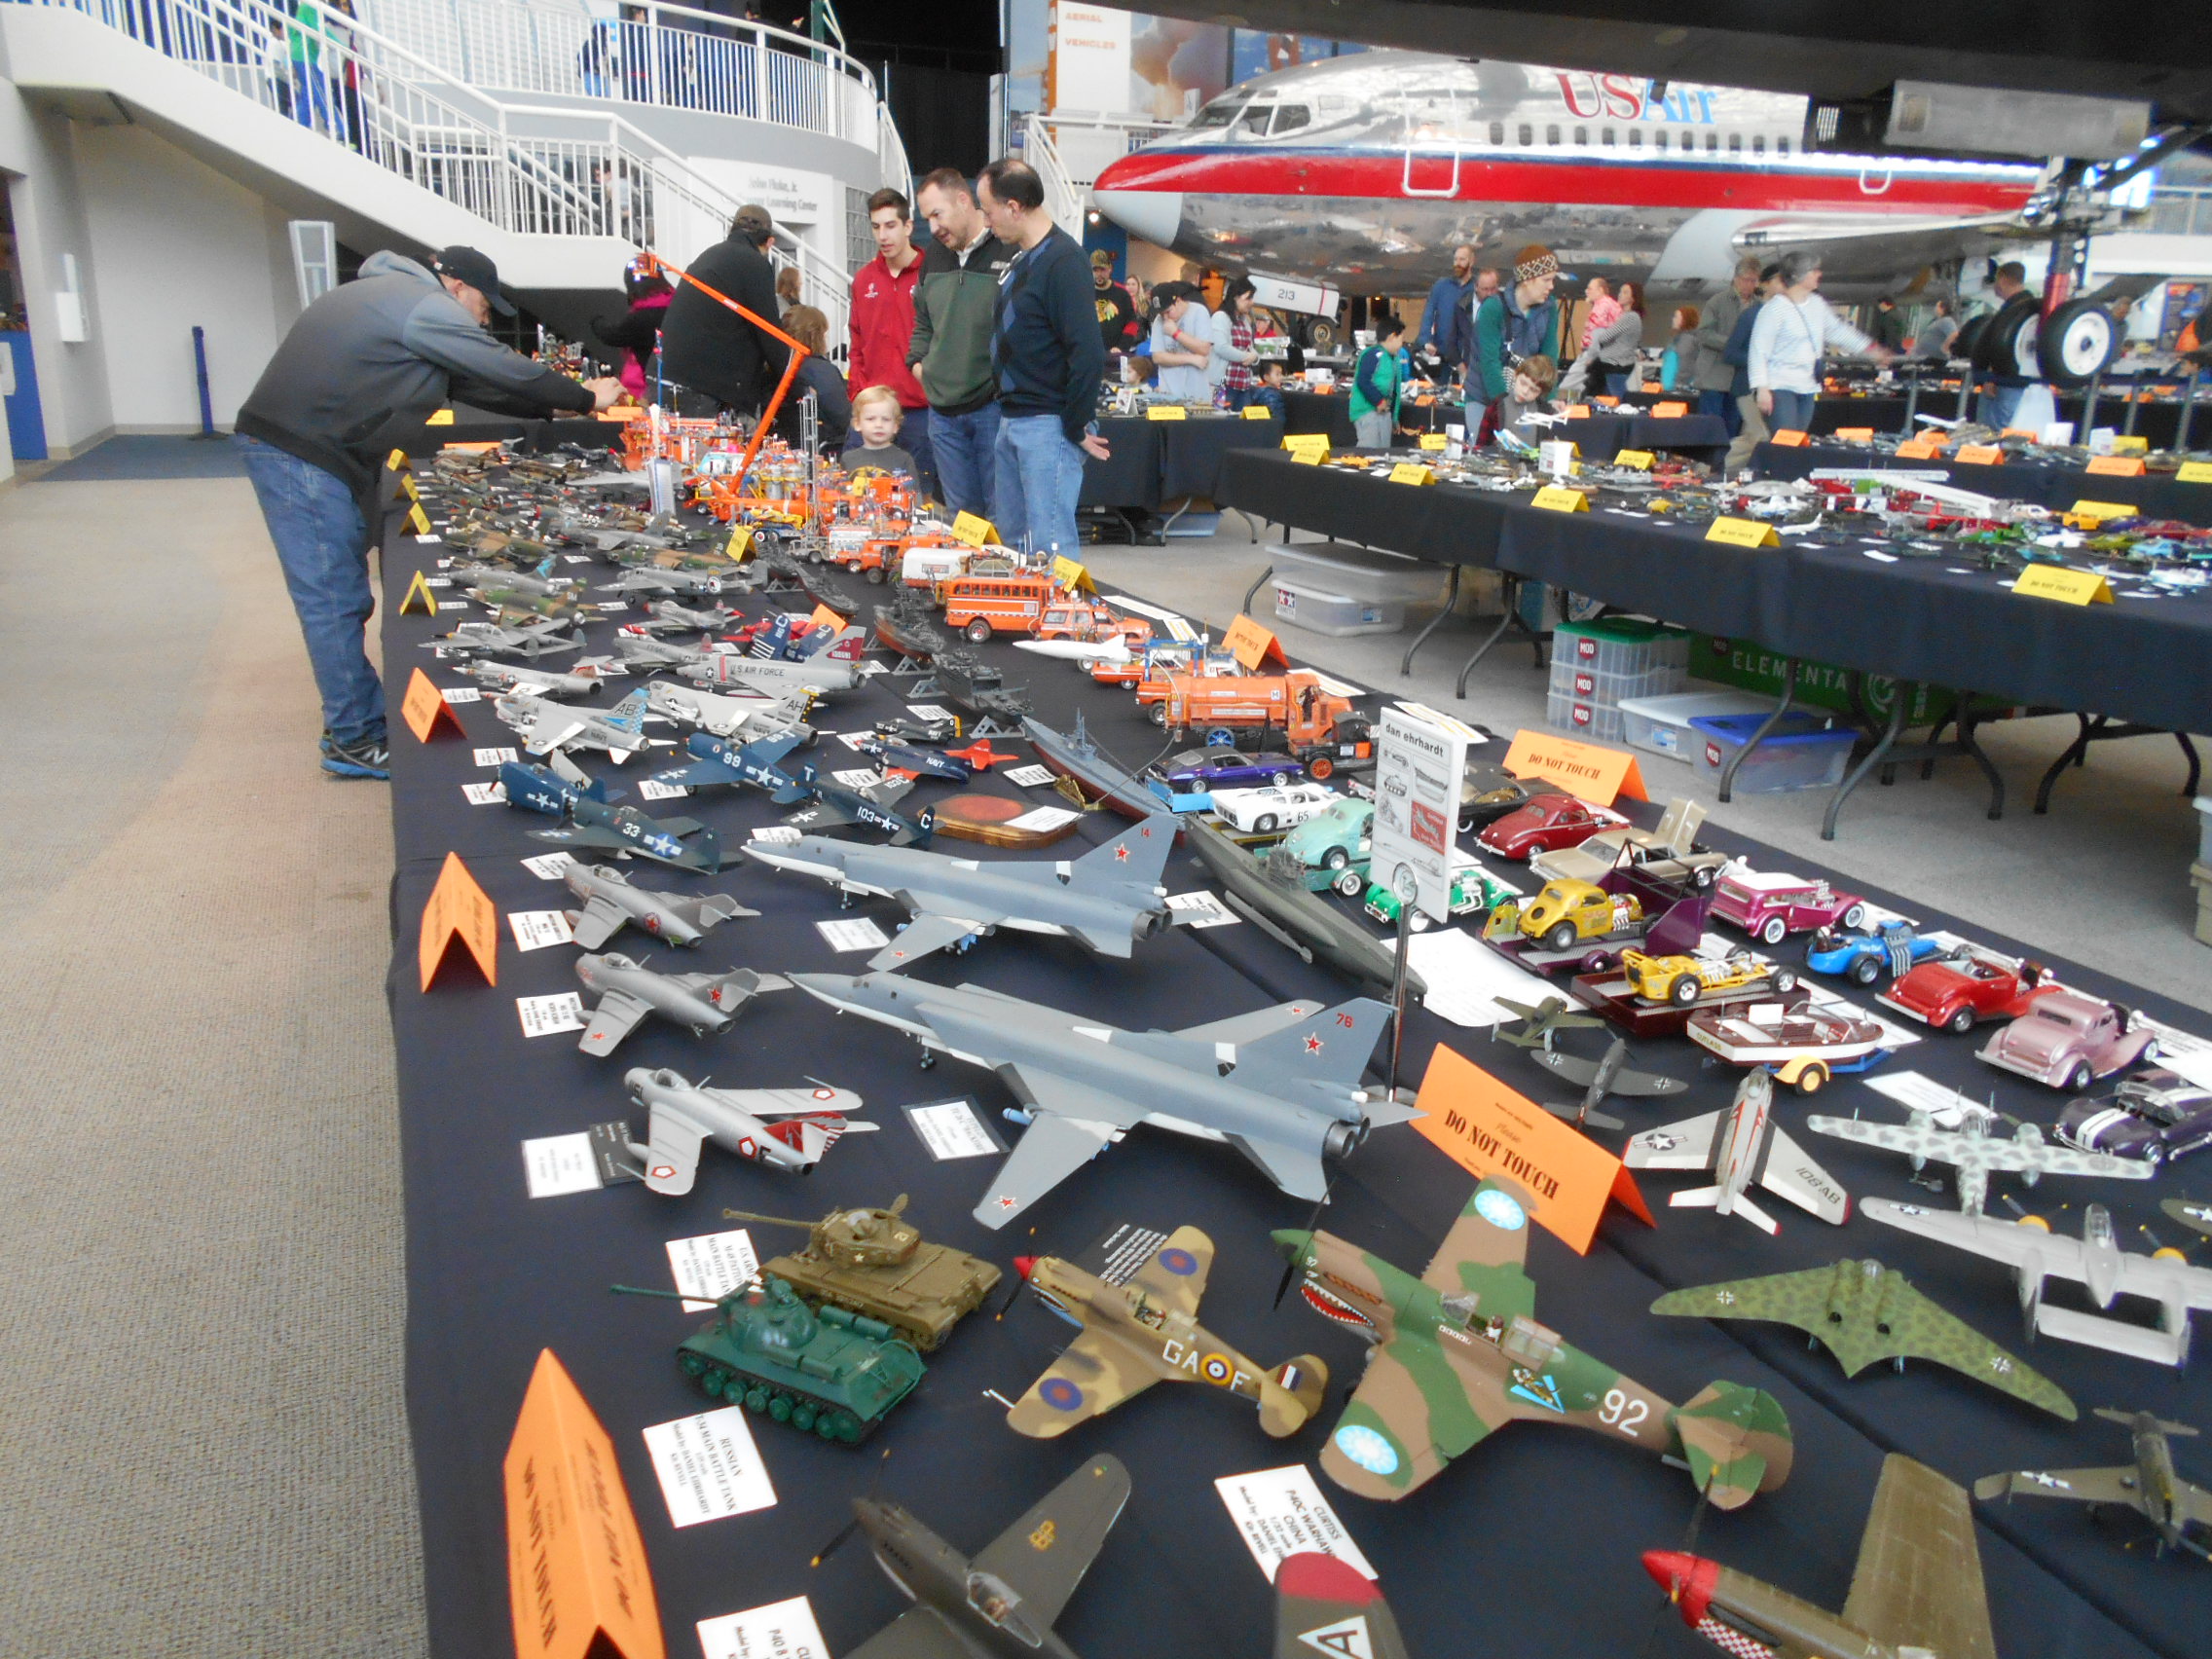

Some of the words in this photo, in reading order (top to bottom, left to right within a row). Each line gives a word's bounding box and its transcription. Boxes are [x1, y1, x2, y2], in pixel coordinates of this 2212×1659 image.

[1065, 13, 1102, 22] AERIAL
[1065, 38, 1117, 50] VEHICLES
[766, 196, 797, 212] Learning
[798, 199, 818, 211] Center
[1277, 288, 1296, 300] 213
[1580, 643, 1594, 654] MOD
[759, 667, 786, 678] FORCE
[1576, 679, 1592, 691] MOD
[615, 703, 638, 717] AB
[786, 700, 804, 713] AH
[1385, 723, 1401, 740] dan
[1403, 731, 1445, 757] ehrhardt
[722, 753, 742, 768] 99
[926, 756, 945, 769] NAVY
[1529, 754, 1542, 764] DO
[1544, 757, 1565, 769] NOT
[1566, 762, 1602, 780] TOUCH
[804, 765, 815, 782] T
[857, 806, 875, 823] 103
[920, 814, 931, 830] C
[1297, 811, 1309, 823] 65
[622, 822, 642, 838] 33
[1141, 827, 1151, 838] 14
[1335, 1013, 1354, 1029] 76
[1444, 1108, 1467, 1134] DO
[1466, 1124, 1501, 1159] NOT
[1502, 1147, 1561, 1200] TOUCH
[719, 1279, 732, 1294] TAN
[1162, 1338, 1199, 1375] GA
[1230, 1370, 1251, 1392] F
[1598, 1388, 1649, 1438] 92
[698, 1428, 718, 1453] MAIN
[680, 1449, 697, 1474] DANIEL
[718, 1437, 744, 1478] RUSSIAN
[707, 1452, 730, 1487] BATTLE
[719, 1486, 738, 1511] TANK
[1236, 1486, 1254, 1503] Model
[1246, 1505, 1261, 1516] by:
[1255, 1519, 1279, 1545] DANIEL
[1283, 1489, 1309, 1513] P40C
[1298, 1514, 1339, 1559] WARHAW
[1310, 1505, 1343, 1540] CURTISS
[1268, 1516, 1285, 1532] 1/32
[1277, 1533, 1294, 1549] scale
[1281, 1515, 1309, 1544] CHINA
[1250, 1533, 1270, 1554] REVELL
